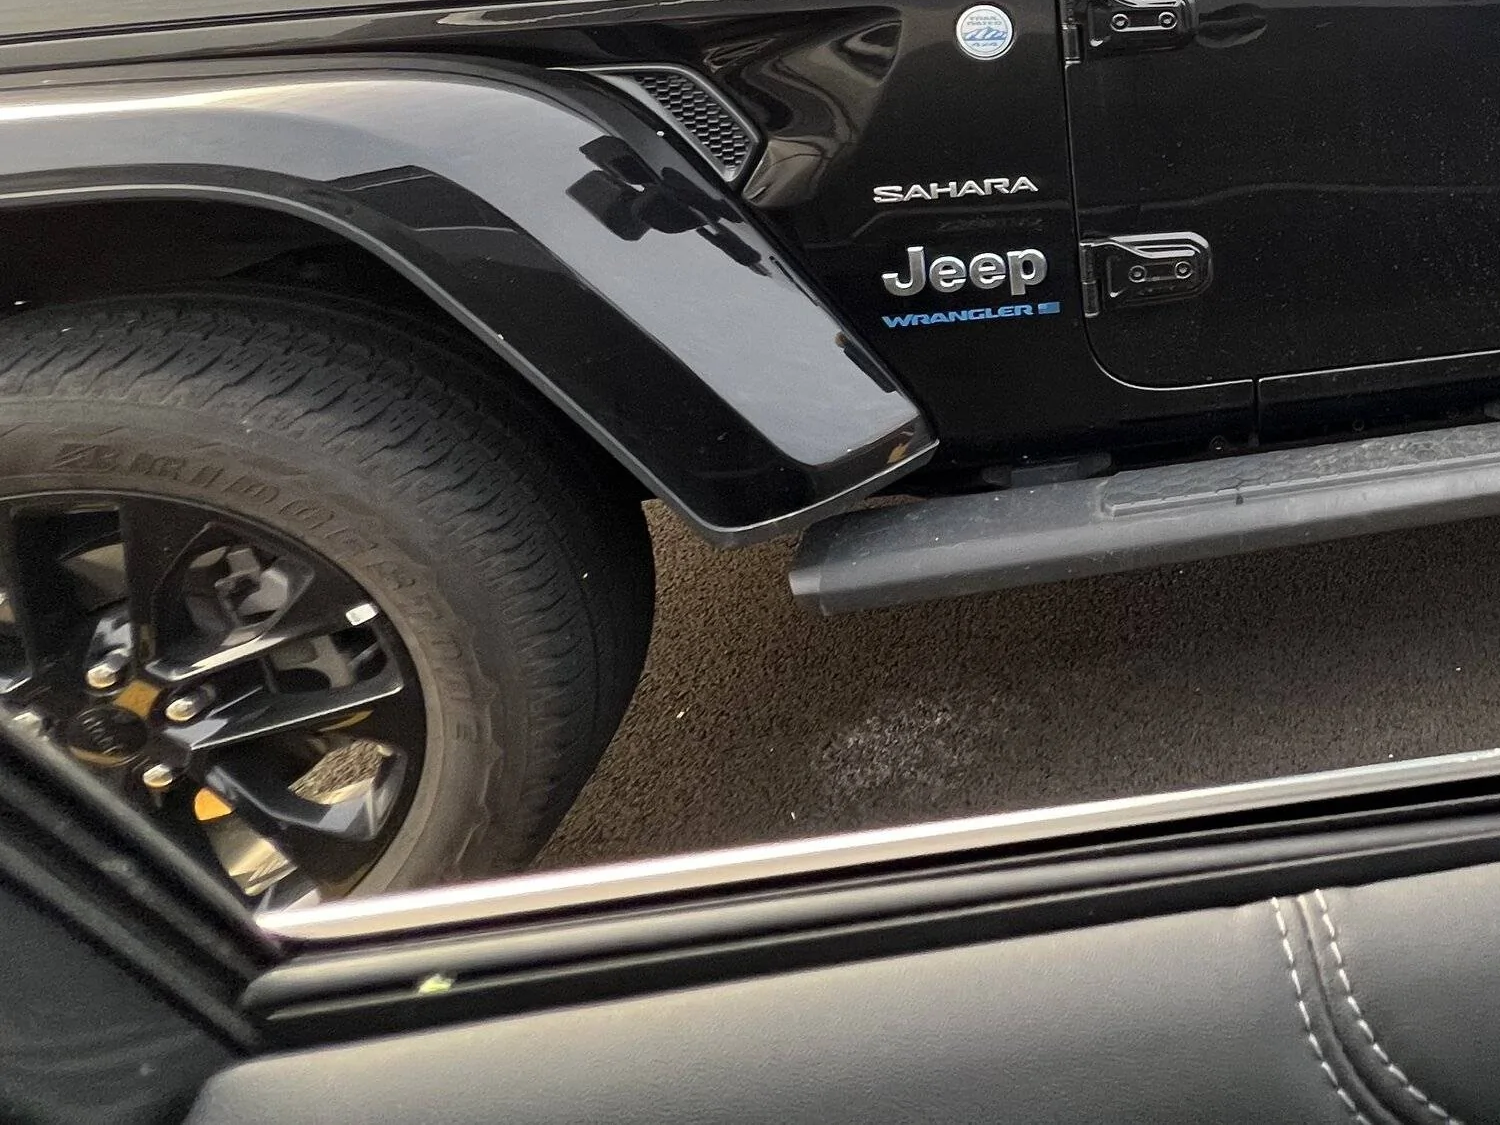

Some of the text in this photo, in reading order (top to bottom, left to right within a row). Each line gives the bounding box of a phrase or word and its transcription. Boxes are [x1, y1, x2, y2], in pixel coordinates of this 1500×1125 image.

[873, 176, 1039, 203] SAHARA
[881, 245, 1048, 296] Jeep
[881, 304, 1034, 328] WRANGLER
